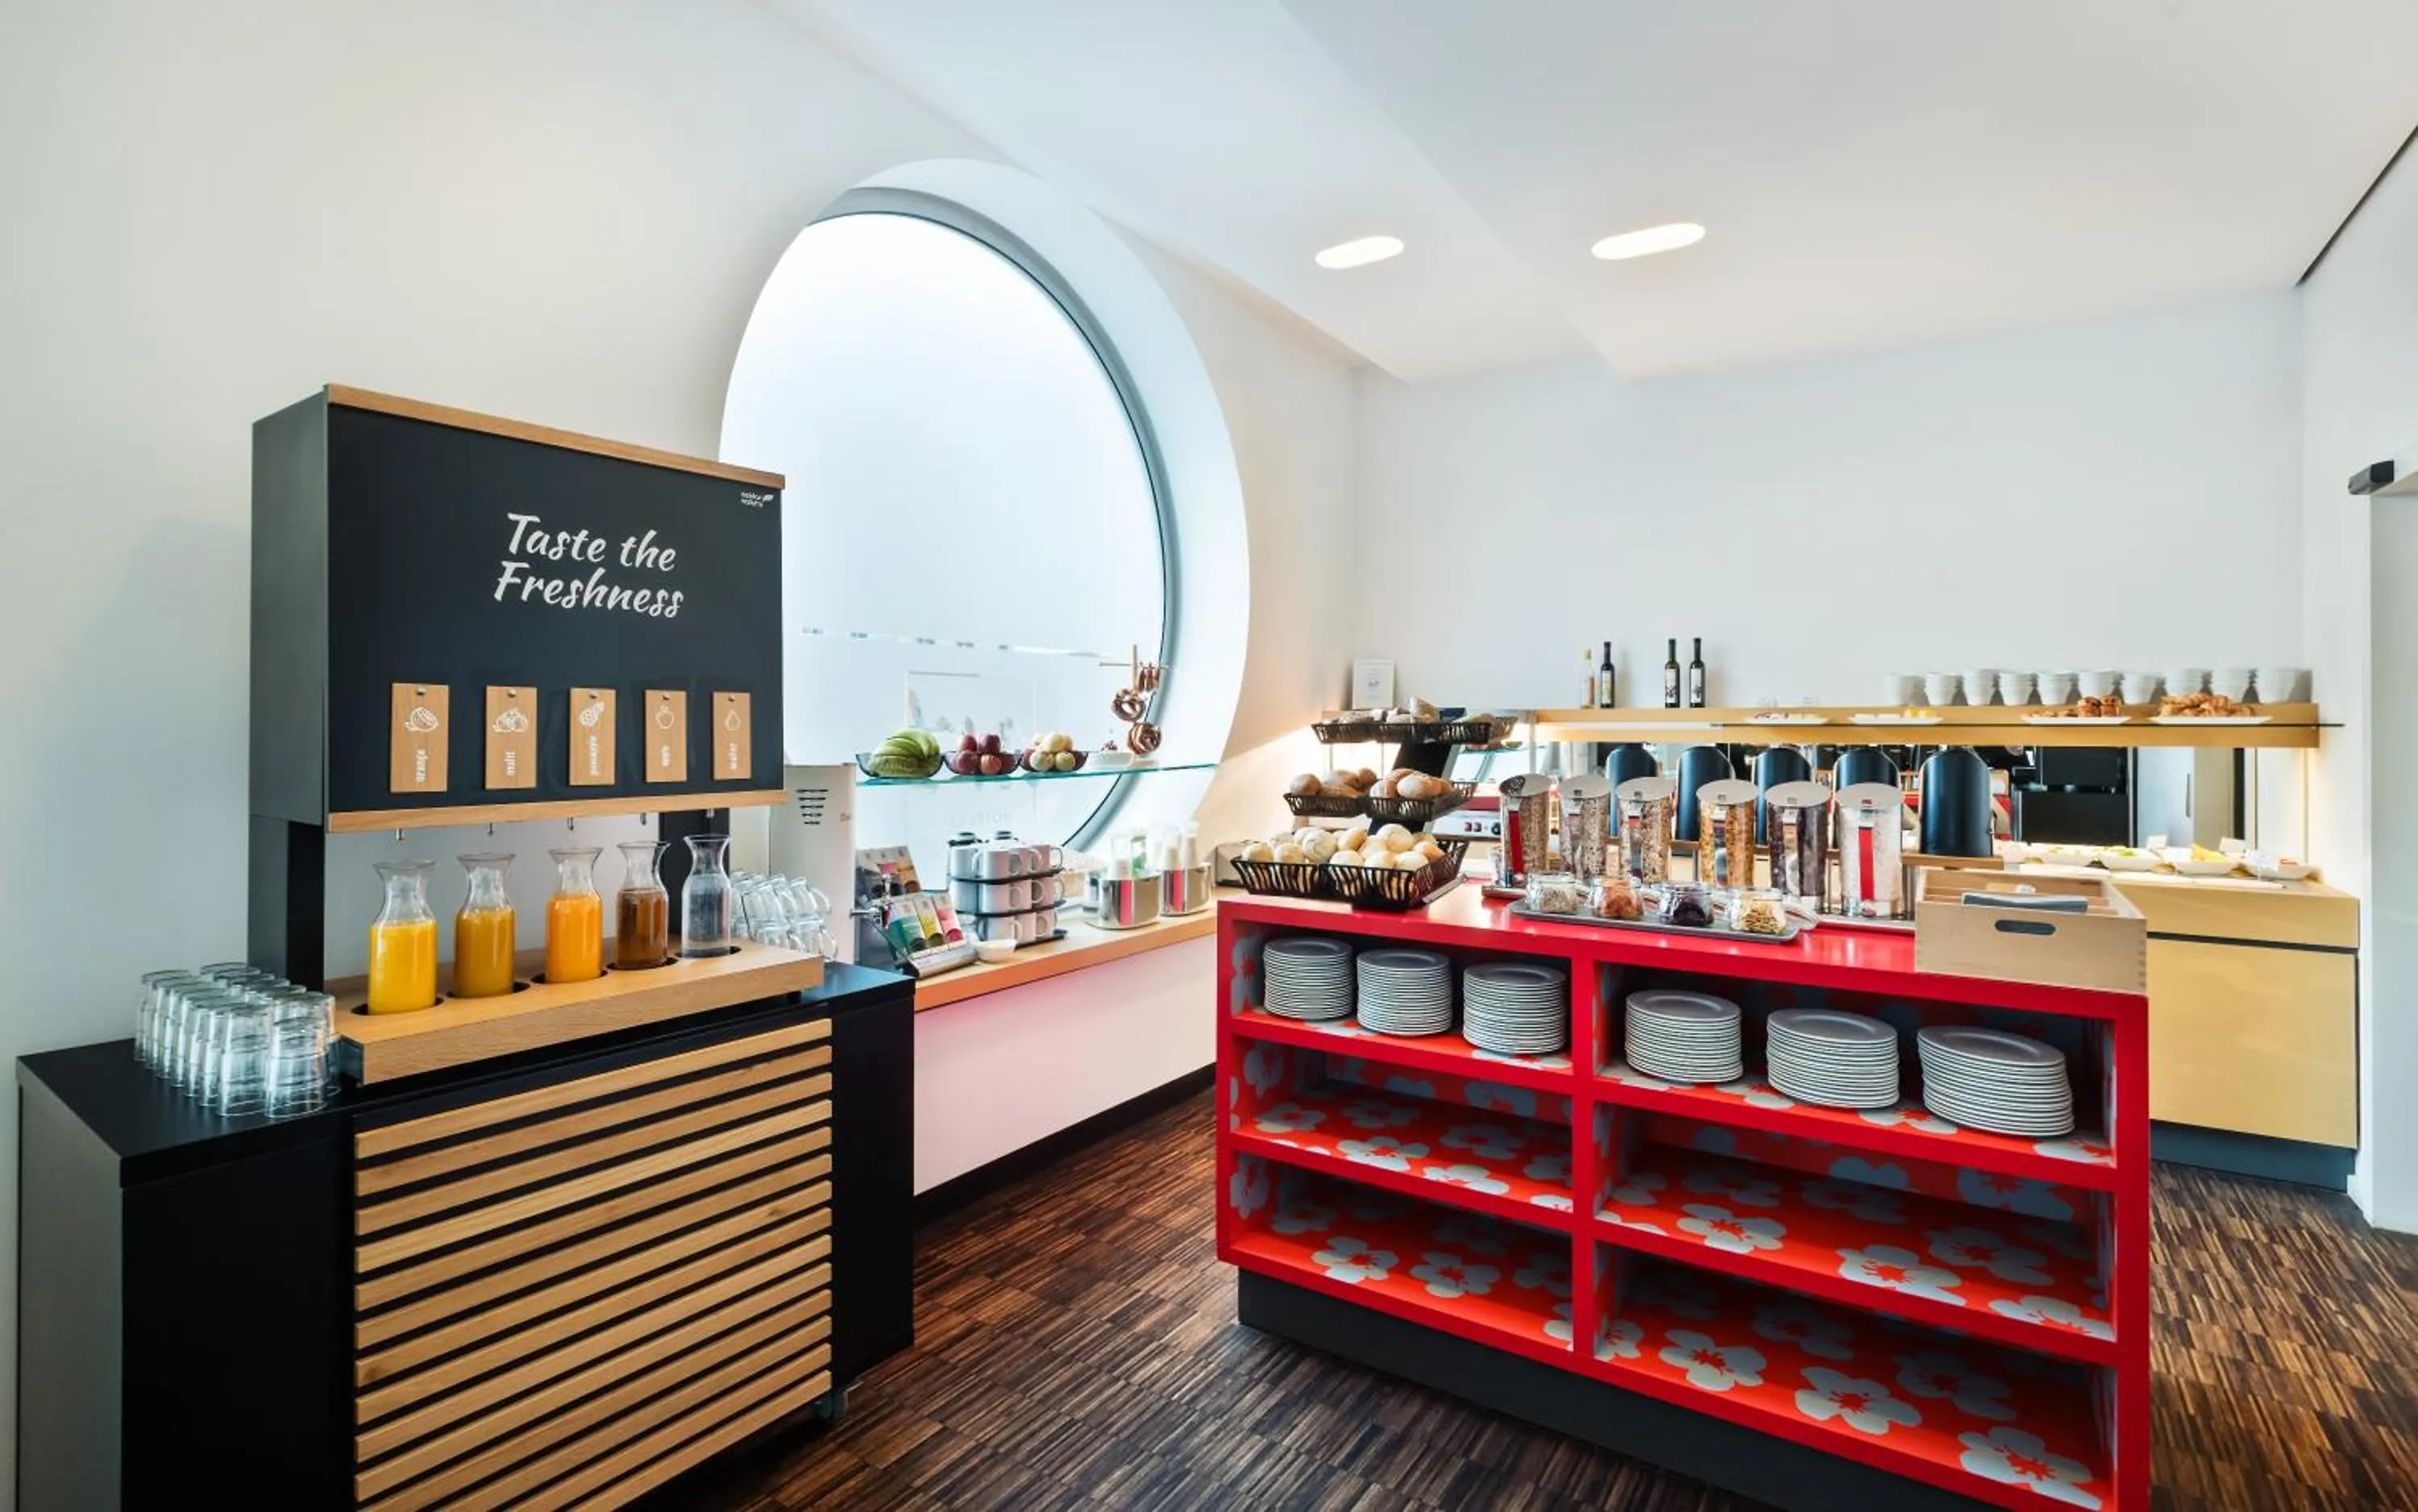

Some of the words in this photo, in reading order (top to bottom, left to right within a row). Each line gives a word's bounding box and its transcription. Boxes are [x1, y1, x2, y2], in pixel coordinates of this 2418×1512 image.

[507, 513, 606, 563] Taste
[620, 530, 676, 571] the
[493, 560, 684, 619] Freshness
[415, 749, 429, 783] orange
[728, 741, 738, 771] water
